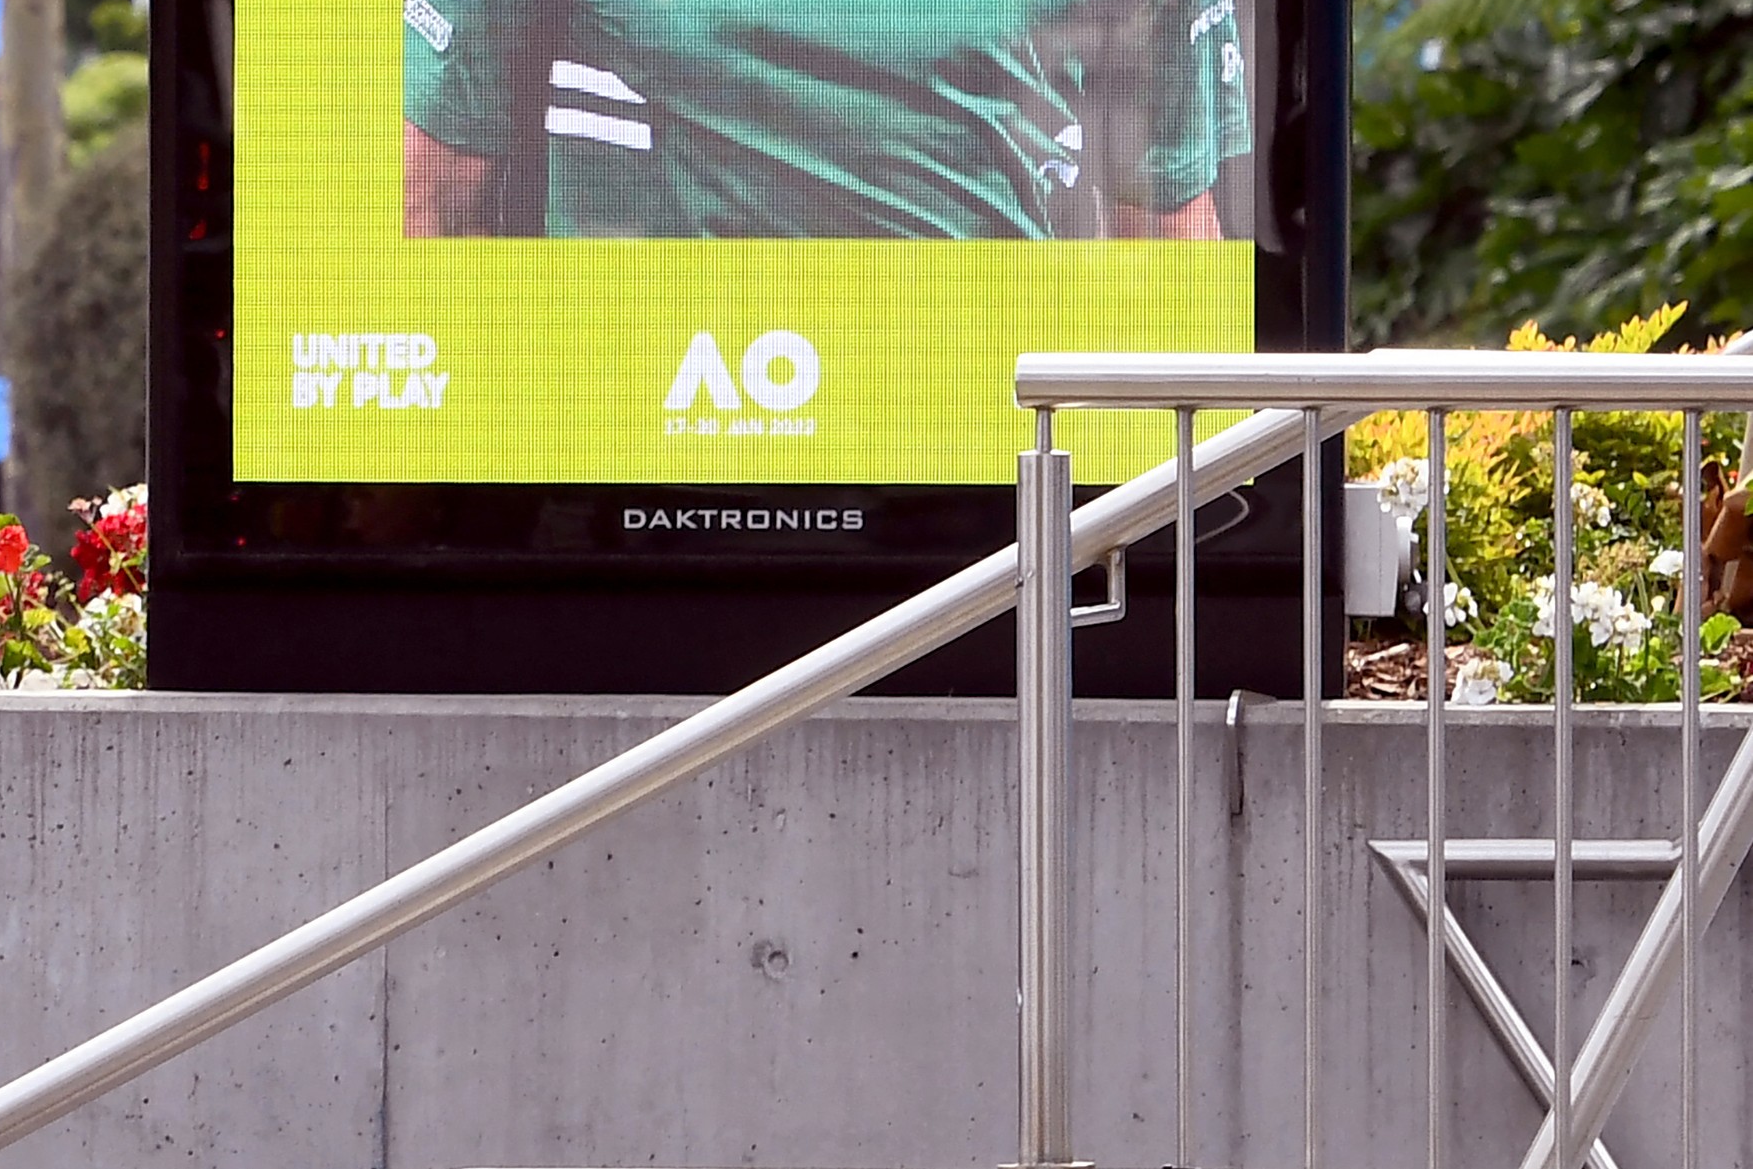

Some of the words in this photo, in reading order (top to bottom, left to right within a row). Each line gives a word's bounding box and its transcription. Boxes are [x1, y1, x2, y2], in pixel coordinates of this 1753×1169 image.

[292, 332, 437, 369] UNITED
[664, 329, 821, 411] AO
[292, 372, 343, 409] BY
[353, 372, 450, 409] PLAY
[623, 508, 864, 530] DAKTRONICS
